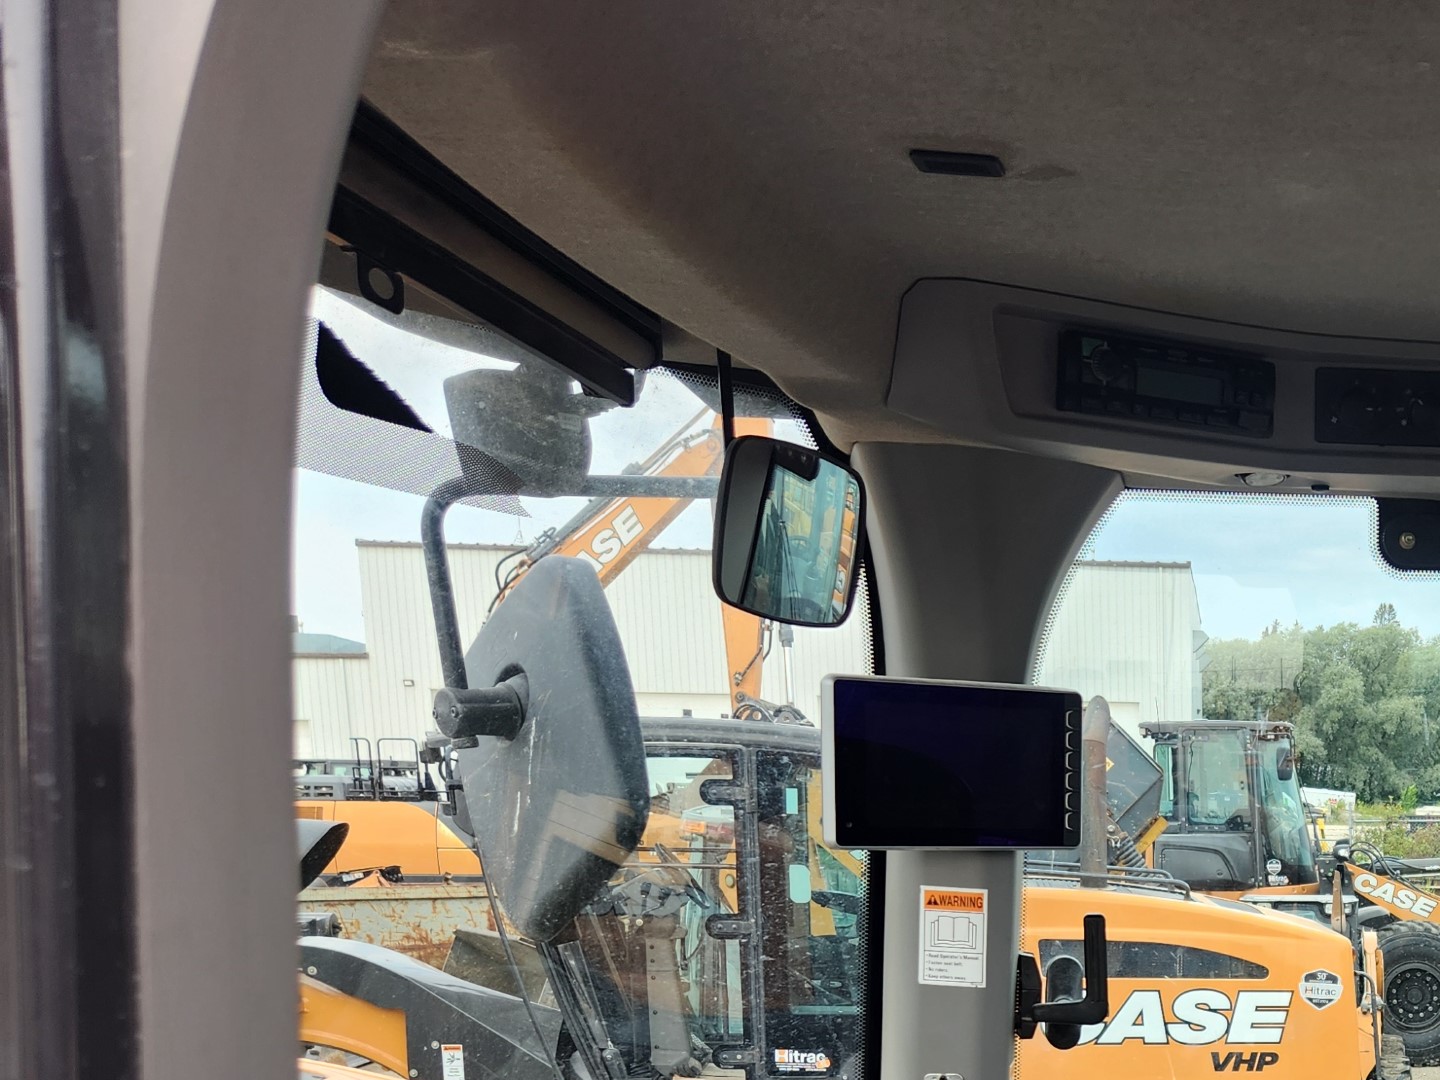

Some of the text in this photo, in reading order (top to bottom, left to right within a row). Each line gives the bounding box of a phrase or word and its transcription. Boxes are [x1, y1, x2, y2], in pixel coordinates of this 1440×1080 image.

[575, 503, 645, 573] SE
[938, 894, 983, 909] WARNING
[1354, 873, 1438, 919] CASE
[1304, 985, 1337, 996] Hitrac
[774, 1048, 830, 1064] Hitrac
[1210, 1051, 1280, 1072] VHP
